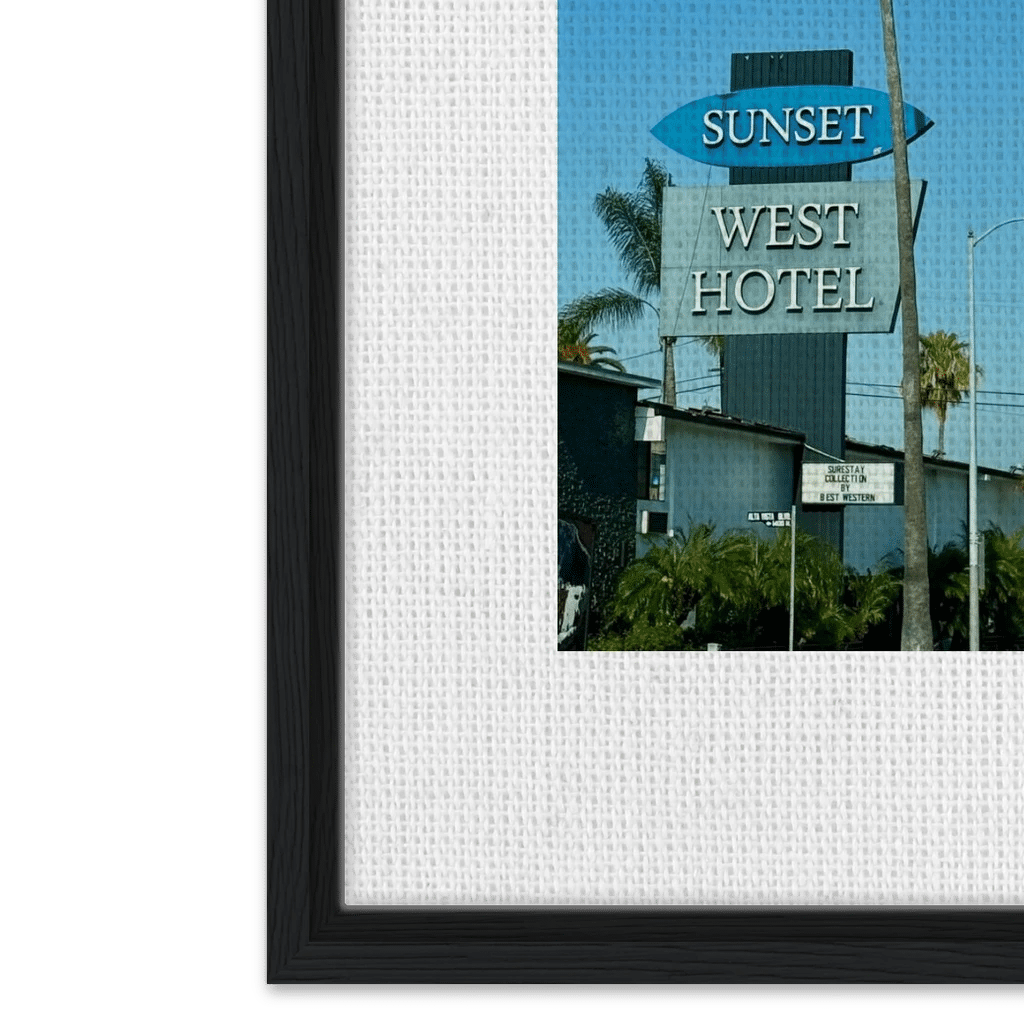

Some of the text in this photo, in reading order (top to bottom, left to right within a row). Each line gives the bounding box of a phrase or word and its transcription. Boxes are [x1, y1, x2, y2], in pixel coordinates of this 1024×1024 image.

[702, 104, 873, 146] SUNSET
[711, 202, 860, 249] WEST
[691, 266, 875, 313] HOTEL
[827, 465, 866, 474] SURESTAY
[824, 474, 867, 483] COLLECTION
[841, 484, 850, 492] BY
[820, 493, 876, 502] BEST WESTERN
